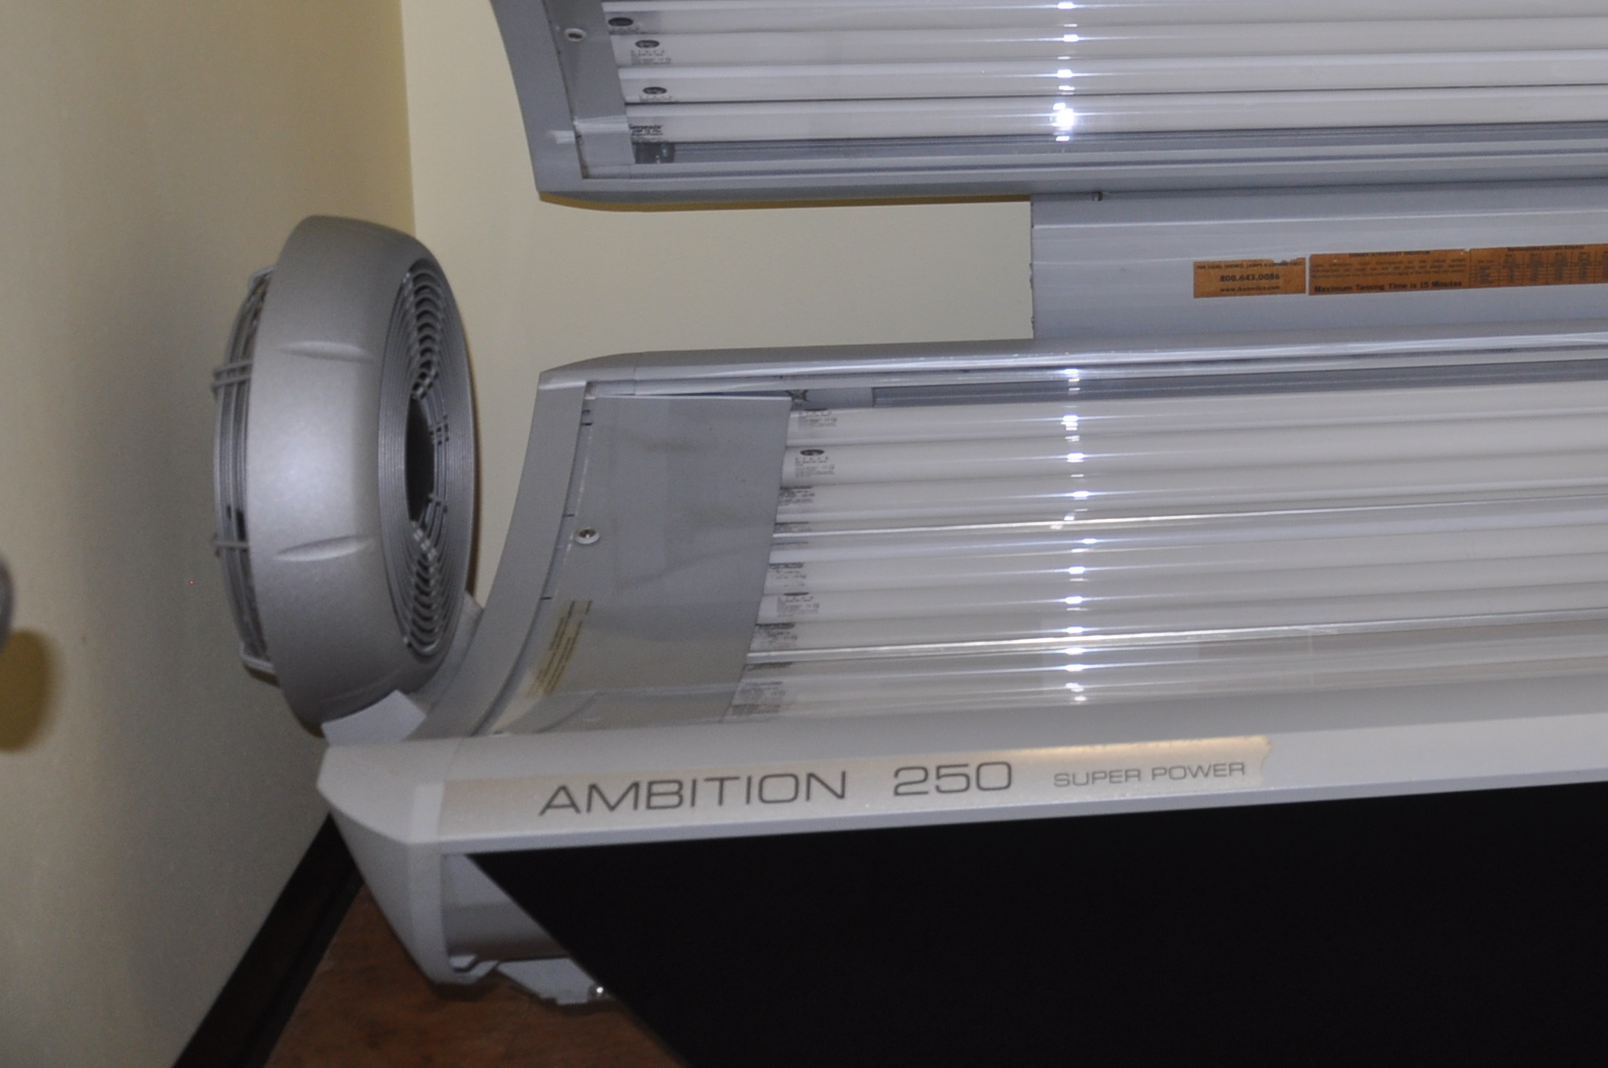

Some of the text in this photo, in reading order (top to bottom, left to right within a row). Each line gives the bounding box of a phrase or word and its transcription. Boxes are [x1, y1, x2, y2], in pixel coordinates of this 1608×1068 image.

[1314, 285, 1352, 293] Maximum
[1355, 283, 1385, 291] Tanning
[1388, 282, 1407, 290] Time
[1431, 280, 1462, 288] Minutes
[538, 761, 1246, 817] AMBITION 250 SUPER POWER
